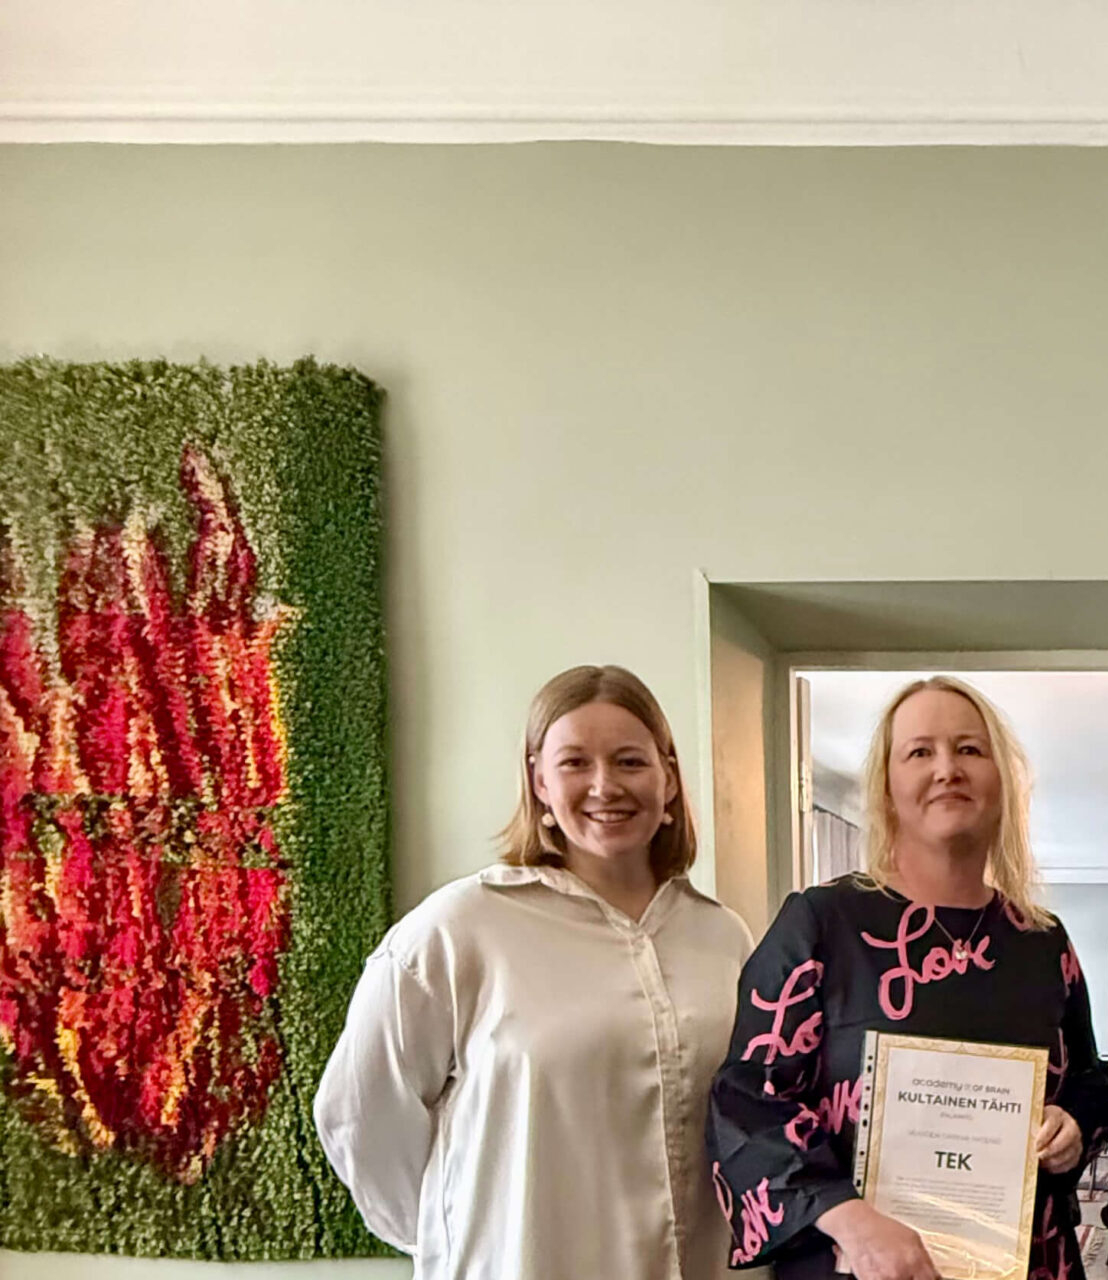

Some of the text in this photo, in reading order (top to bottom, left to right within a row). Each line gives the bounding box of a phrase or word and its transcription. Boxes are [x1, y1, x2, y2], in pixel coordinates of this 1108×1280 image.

[861, 902, 996, 1020] Love
[912, 1078, 1010, 1095] academy OF BRAIN
[898, 1091, 1022, 1114] KULTAINEN TÄHTI
[934, 1151, 972, 1171] TEK
